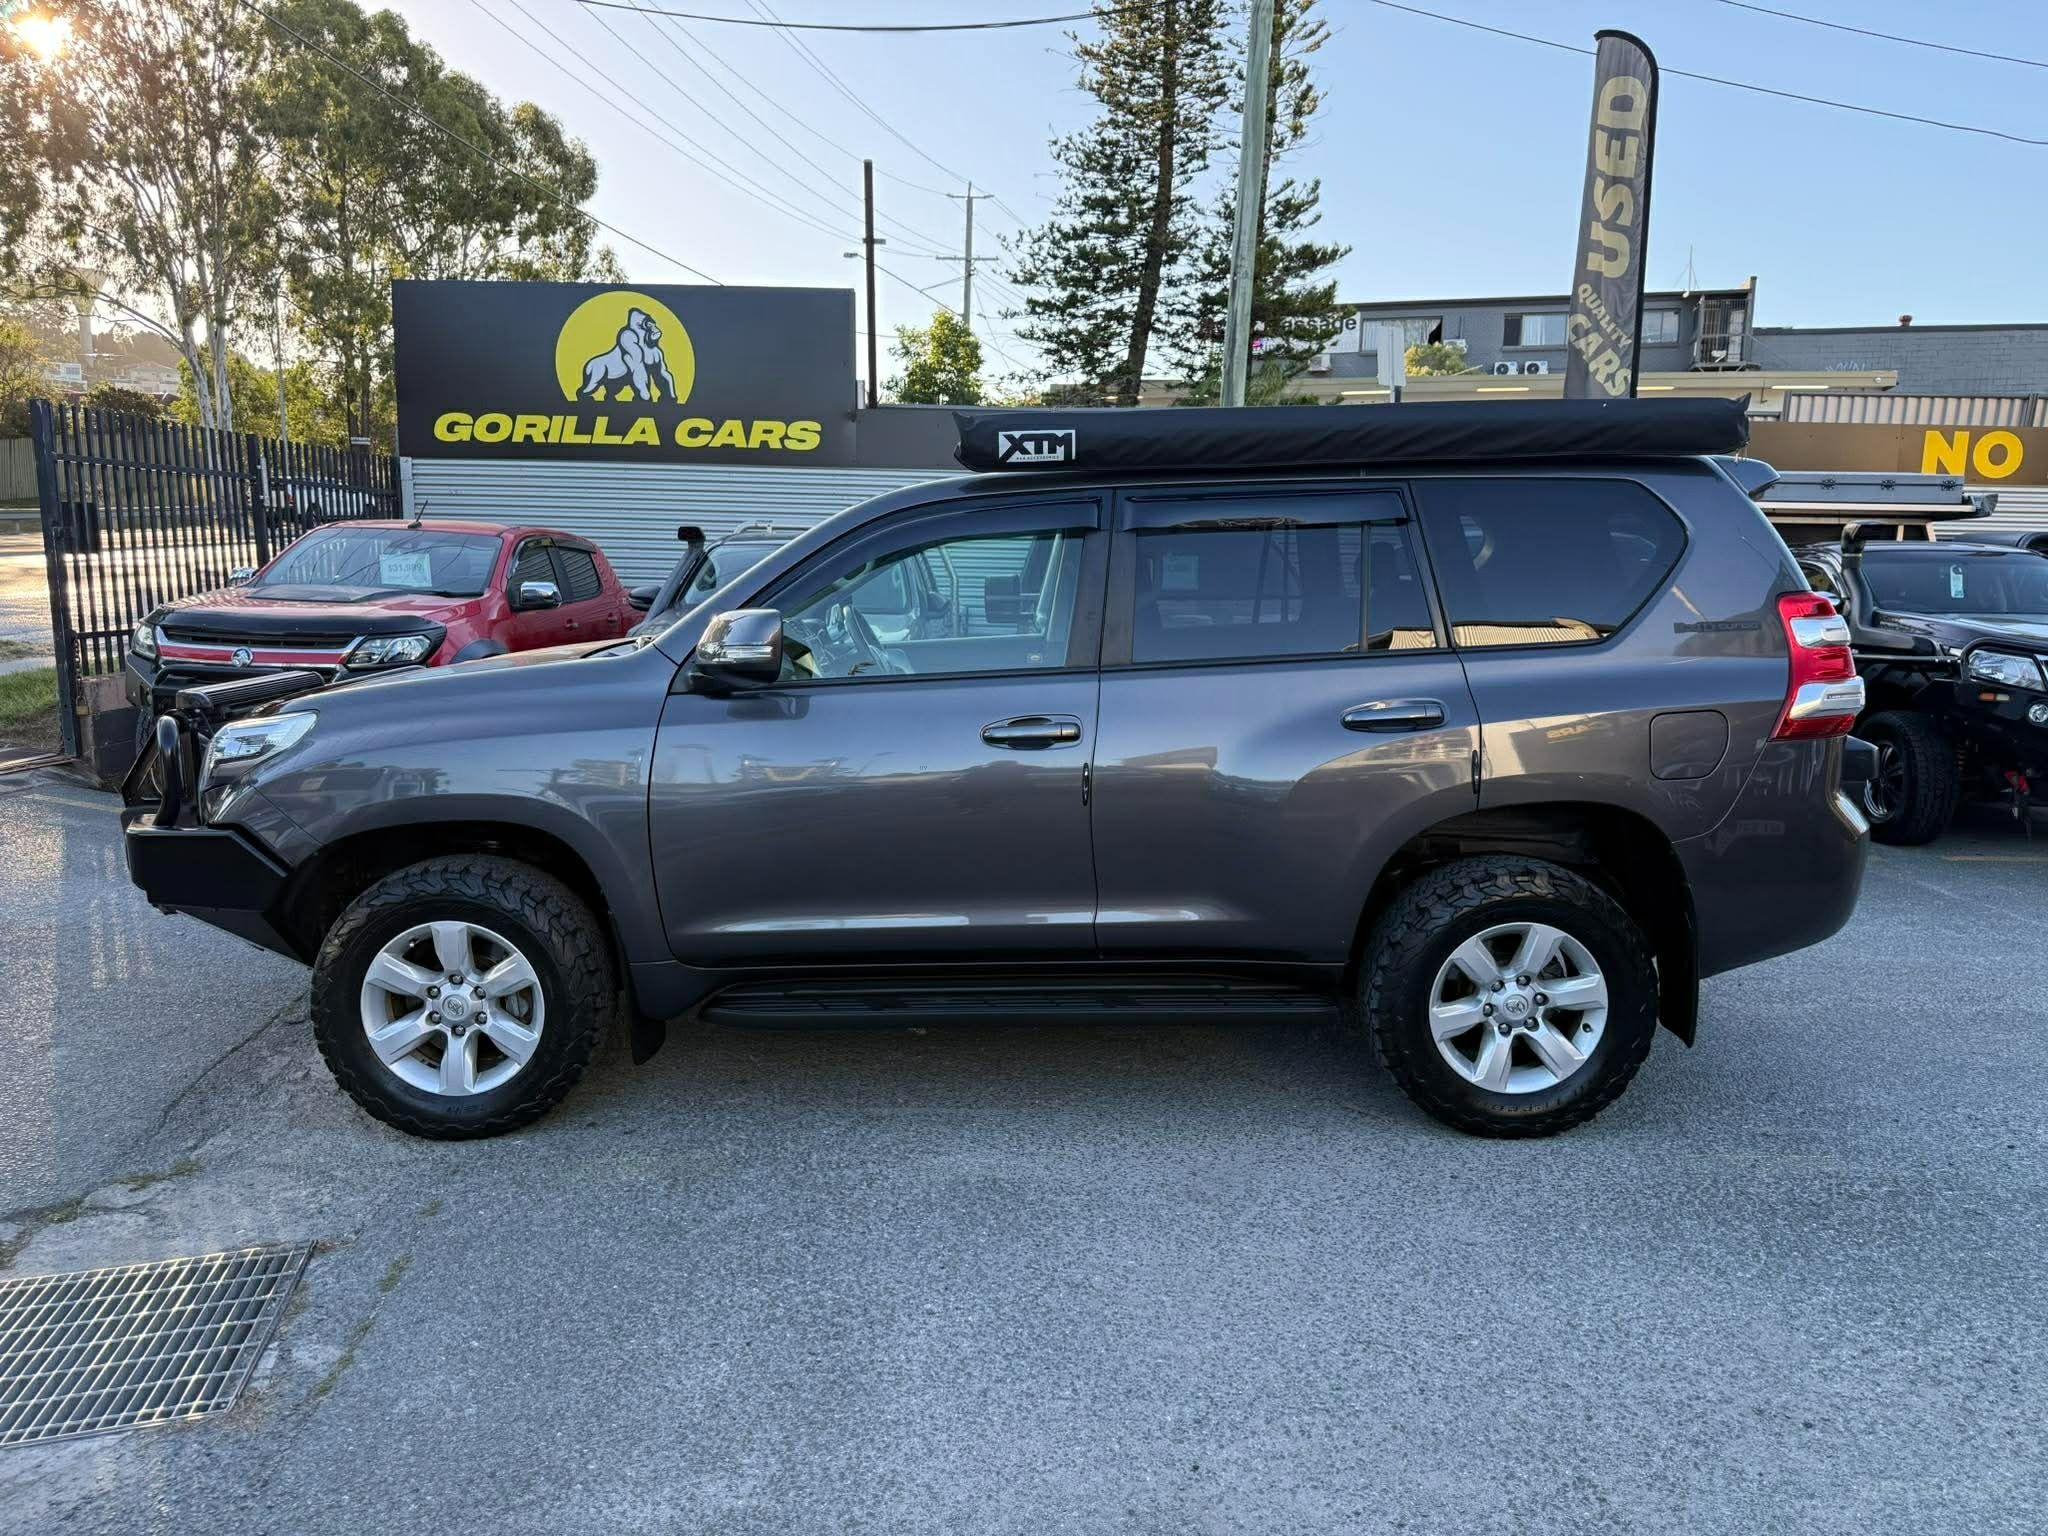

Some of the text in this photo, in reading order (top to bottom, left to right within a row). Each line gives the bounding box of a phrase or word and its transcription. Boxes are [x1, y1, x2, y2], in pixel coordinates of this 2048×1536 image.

[1586, 75, 1648, 279] USED
[1272, 315, 1357, 334] assage
[1577, 282, 1633, 348] QUALITY
[1568, 312, 1632, 398] CARS
[433, 412, 822, 451] GORILLA CARS
[1000, 432, 1073, 463] XTM
[1921, 430, 2024, 479] NO
